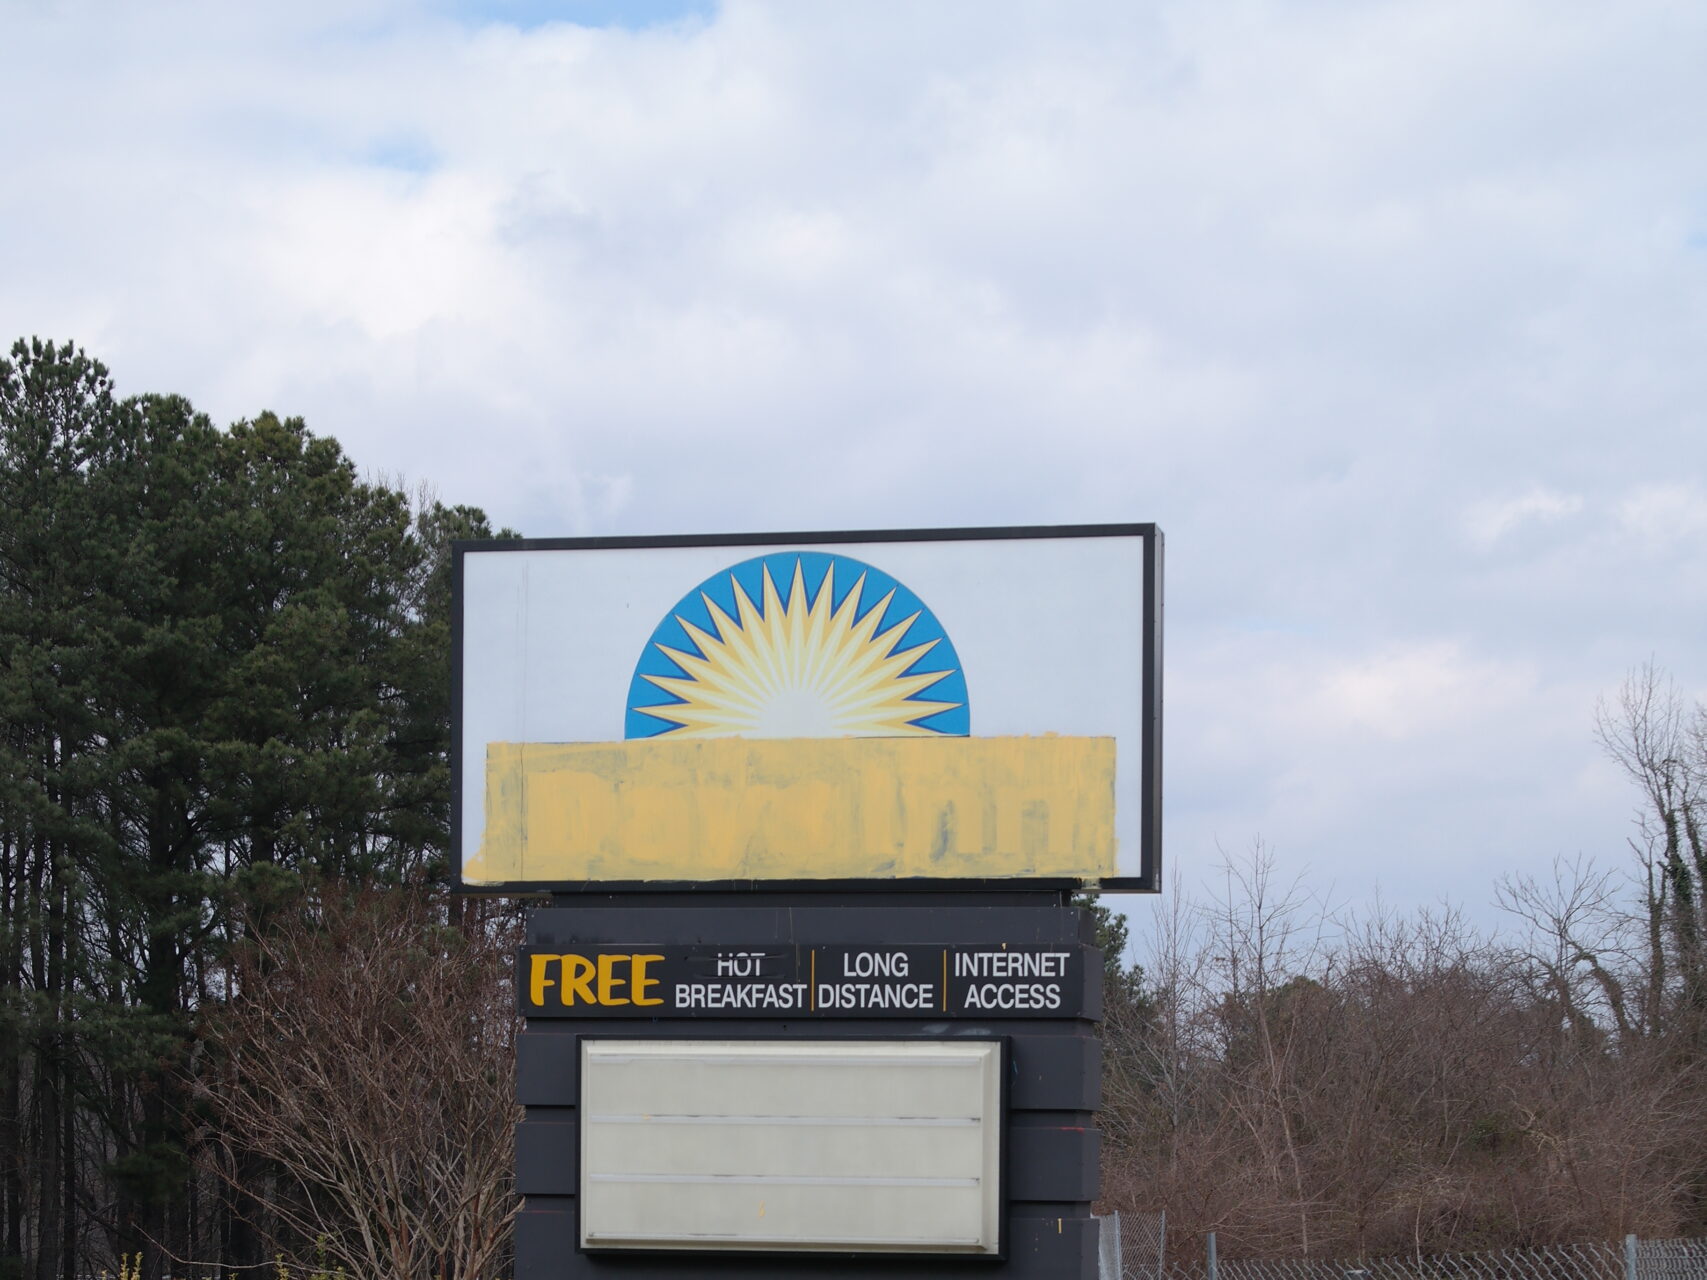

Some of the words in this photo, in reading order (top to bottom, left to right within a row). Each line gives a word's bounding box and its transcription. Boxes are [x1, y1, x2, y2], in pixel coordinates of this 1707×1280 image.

[717, 952, 765, 976] HOT
[844, 952, 908, 977] LONG
[955, 952, 1070, 977] INTERNET
[530, 954, 665, 1006] FREE
[675, 984, 807, 1008] BREAKFAST
[818, 984, 933, 1008] DISTANCE
[964, 984, 1061, 1009] ACCESS
